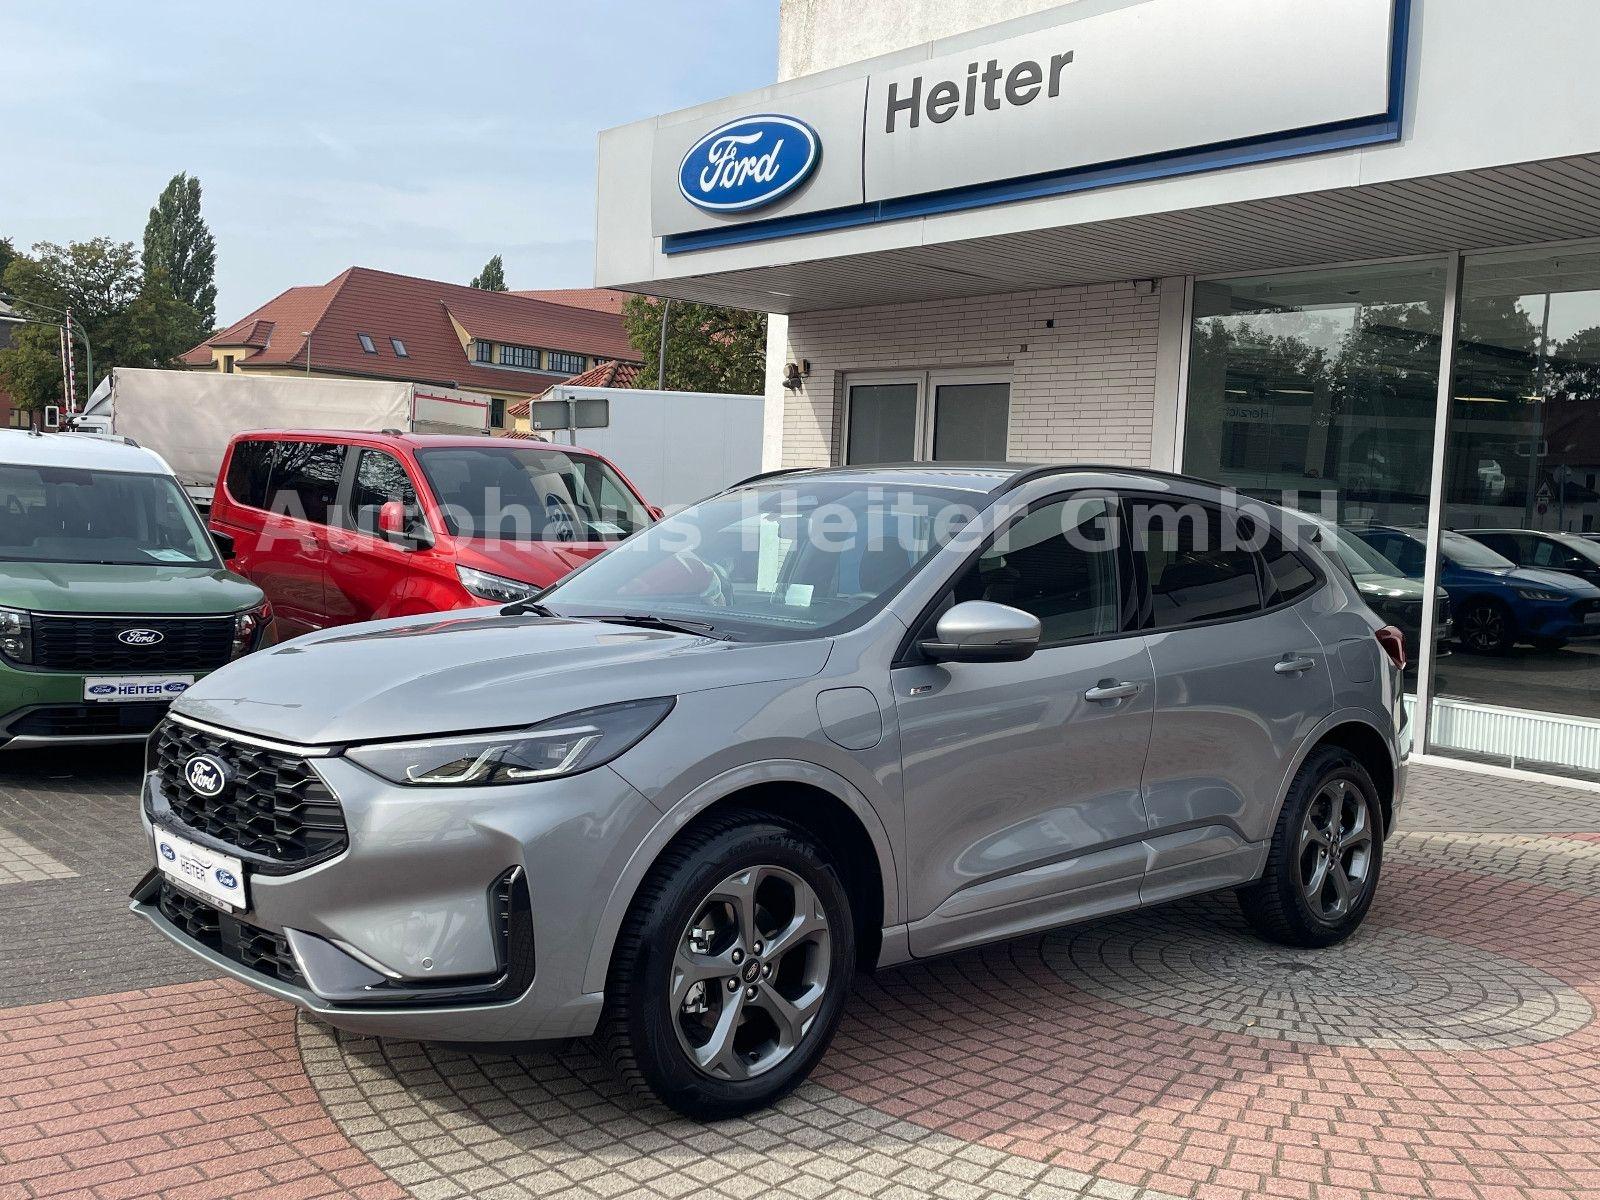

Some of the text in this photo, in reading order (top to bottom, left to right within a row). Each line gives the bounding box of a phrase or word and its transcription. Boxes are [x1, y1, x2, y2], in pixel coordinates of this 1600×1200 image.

[885, 49, 1073, 133] Heiter
[700, 130, 784, 193] Ford
[127, 631, 155, 643] Ford
[118, 685, 162, 695] HEITER
[191, 761, 216, 790] Ford
[180, 858, 206, 882] HEITER
